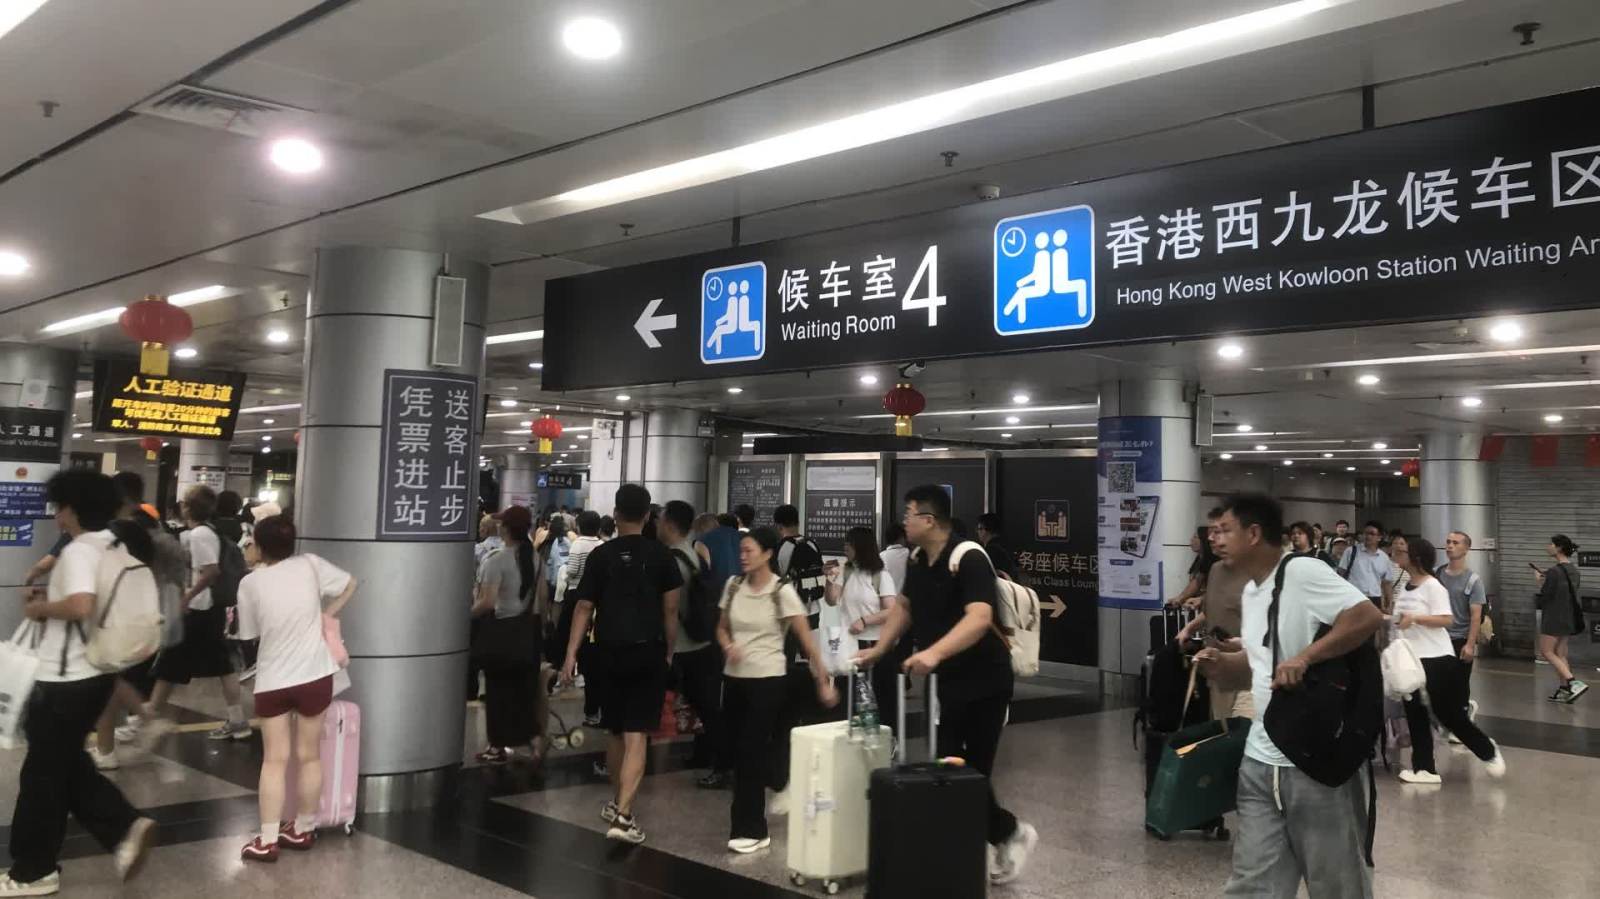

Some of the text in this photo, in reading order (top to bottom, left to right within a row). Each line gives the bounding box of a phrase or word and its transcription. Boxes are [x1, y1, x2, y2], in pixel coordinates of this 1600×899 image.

[1105, 145, 1600, 270] 香港西九龙候车区
[777, 244, 947, 327] 候车室 4
[1116, 287, 1163, 306] Hong
[1169, 281, 1216, 301] Kong
[1222, 273, 1273, 295] West
[1279, 265, 1369, 289] Kowloon
[1376, 256, 1457, 279] Station
[1465, 243, 1561, 269] Waiting
[781, 313, 896, 341] Waiting Room
[392, 385, 434, 527] 凭票进站
[439, 389, 470, 527] 送客止步
[1016, 551, 1098, 575] 务座候车区
